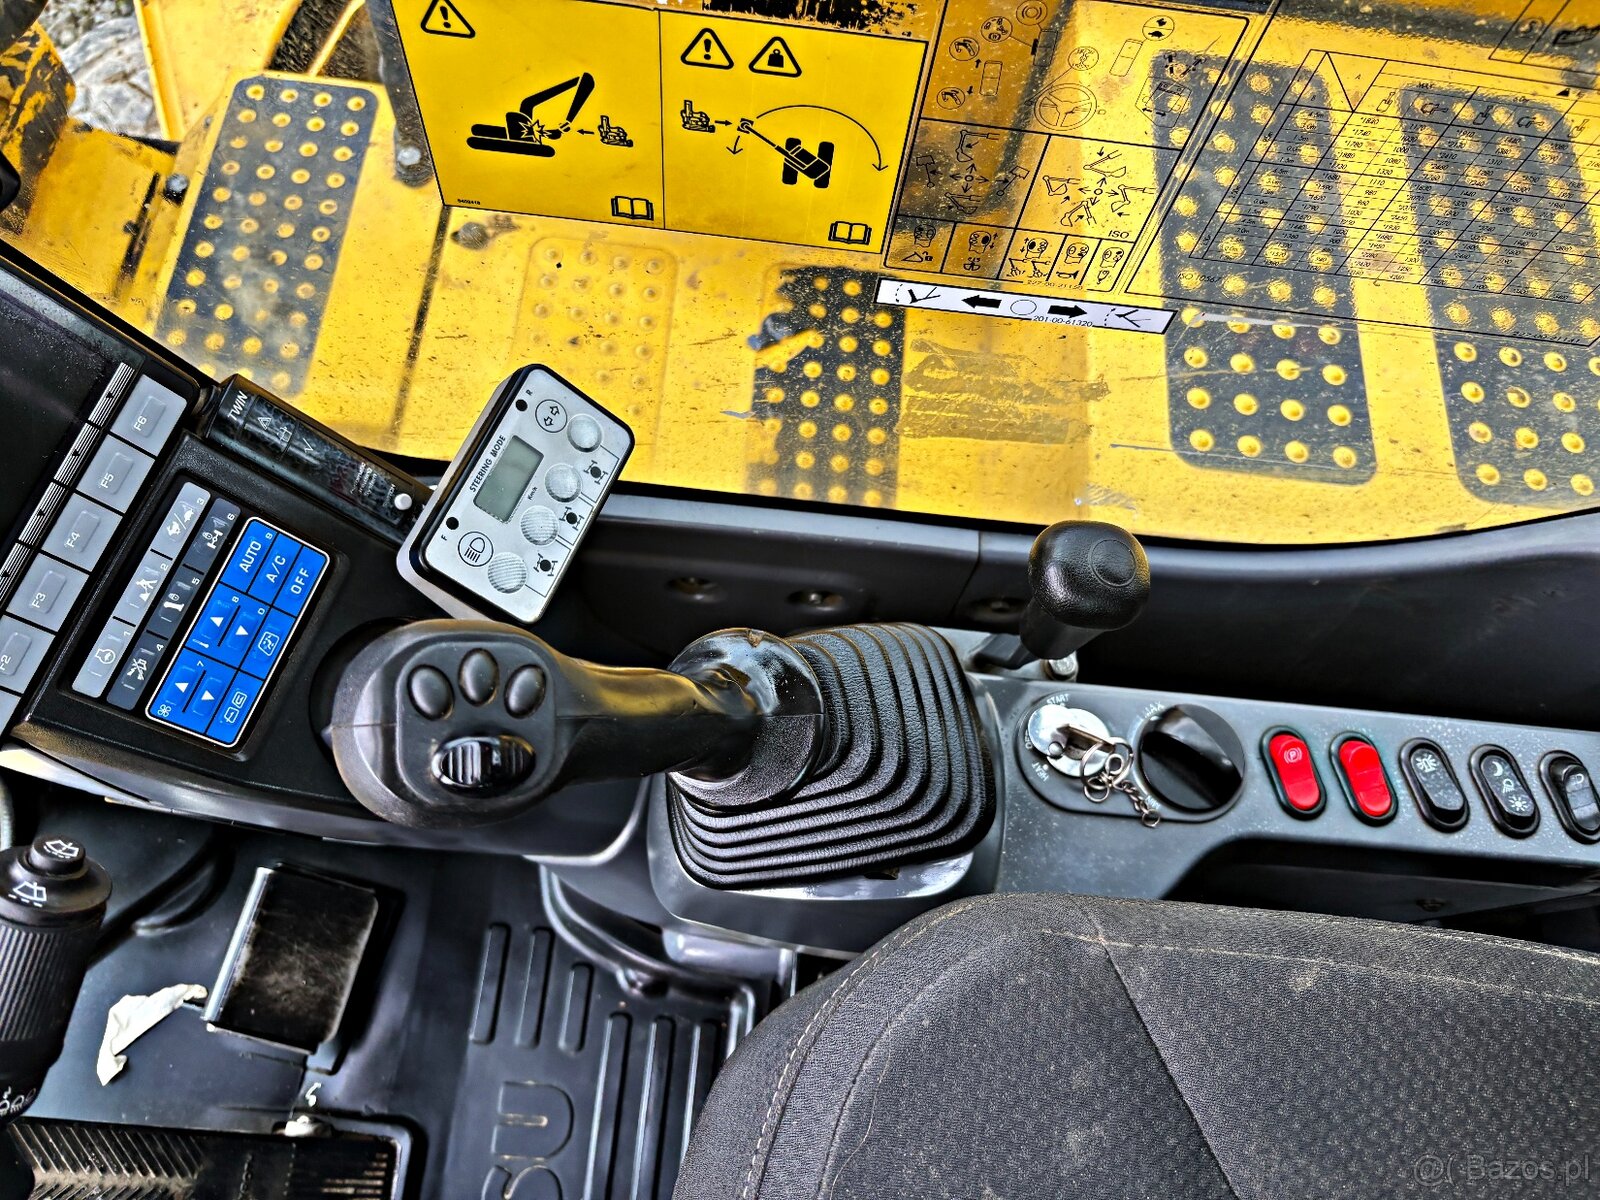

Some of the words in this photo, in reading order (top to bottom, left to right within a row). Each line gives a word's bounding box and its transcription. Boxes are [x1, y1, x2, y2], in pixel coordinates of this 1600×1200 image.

[1107, 229, 1131, 239] ISO
[1033, 315, 1093, 328] 201-00-61320
[227, 390, 249, 422] TWIN
[133, 415, 148, 431] F6
[470, 459, 492, 492] STEERING
[490, 434, 507, 458] MODE
[100, 473, 114, 489] F5
[197, 498, 205, 506] 3
[226, 512, 235, 521] 6
[65, 532, 81, 549] F4
[238, 540, 262, 574] AUTO
[265, 554, 287, 584] A/C
[191, 577, 200, 585] 5
[290, 567, 311, 595] OFF
[31, 592, 47, 608] F3
[231, 595, 240, 604] 8
[156, 643, 165, 652] 4
[1046, 693, 1070, 704] START
[1032, 762, 1050, 782] HEAT
